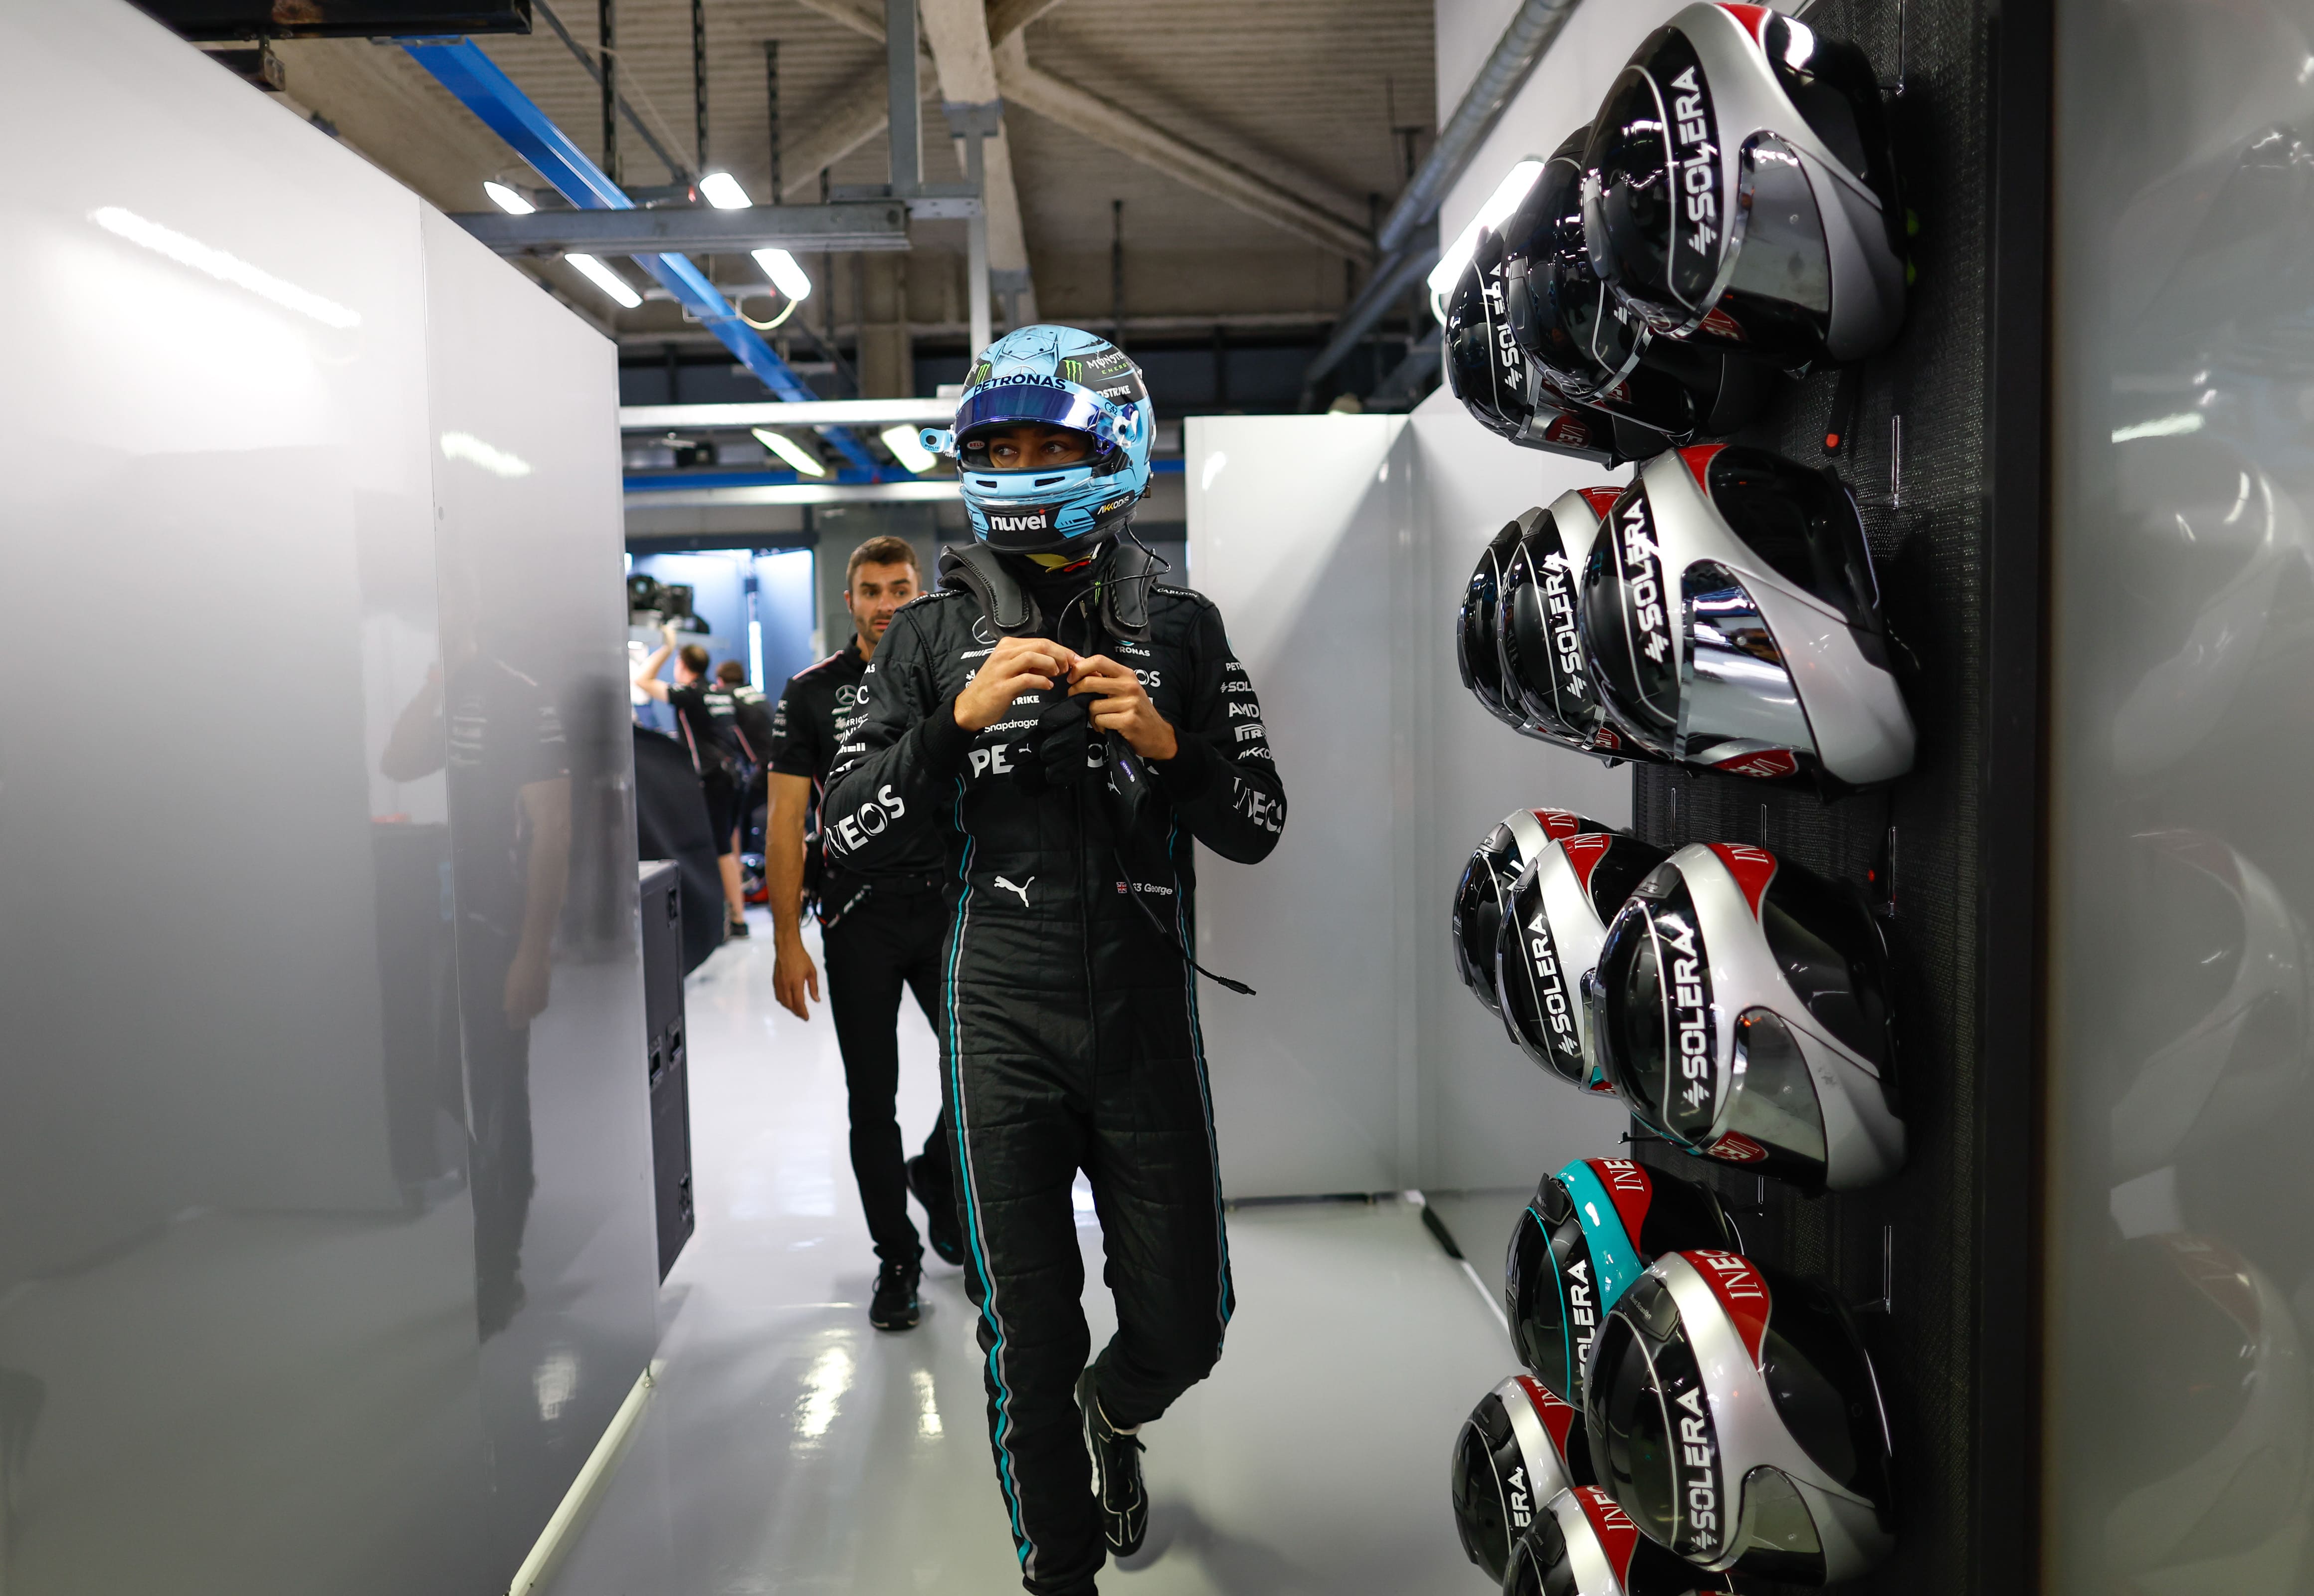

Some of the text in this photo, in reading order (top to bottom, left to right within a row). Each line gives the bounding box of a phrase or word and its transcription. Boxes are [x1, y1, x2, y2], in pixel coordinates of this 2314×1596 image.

[1671, 65, 1716, 221] SOLERA
[973, 374, 1066, 396] PETRONAS
[990, 509, 1047, 531] nuvei
[1097, 496, 1130, 515] AKKODIS
[1623, 498, 1664, 632] SOLERA
[1157, 588, 1197, 598] CARLTON
[1542, 550, 1583, 673] SOLERA
[1114, 646, 1151, 656] TRONAS
[1229, 702, 1260, 718] AMD
[1233, 777, 1282, 834] INEO
[1144, 883, 1173, 895] George
[1528, 913, 1572, 1034] SOLERA
[1671, 927, 1709, 1079] SOLERA
[1695, 1249, 1764, 1299] INEO
[1676, 1386, 1716, 1531] SOLERA
